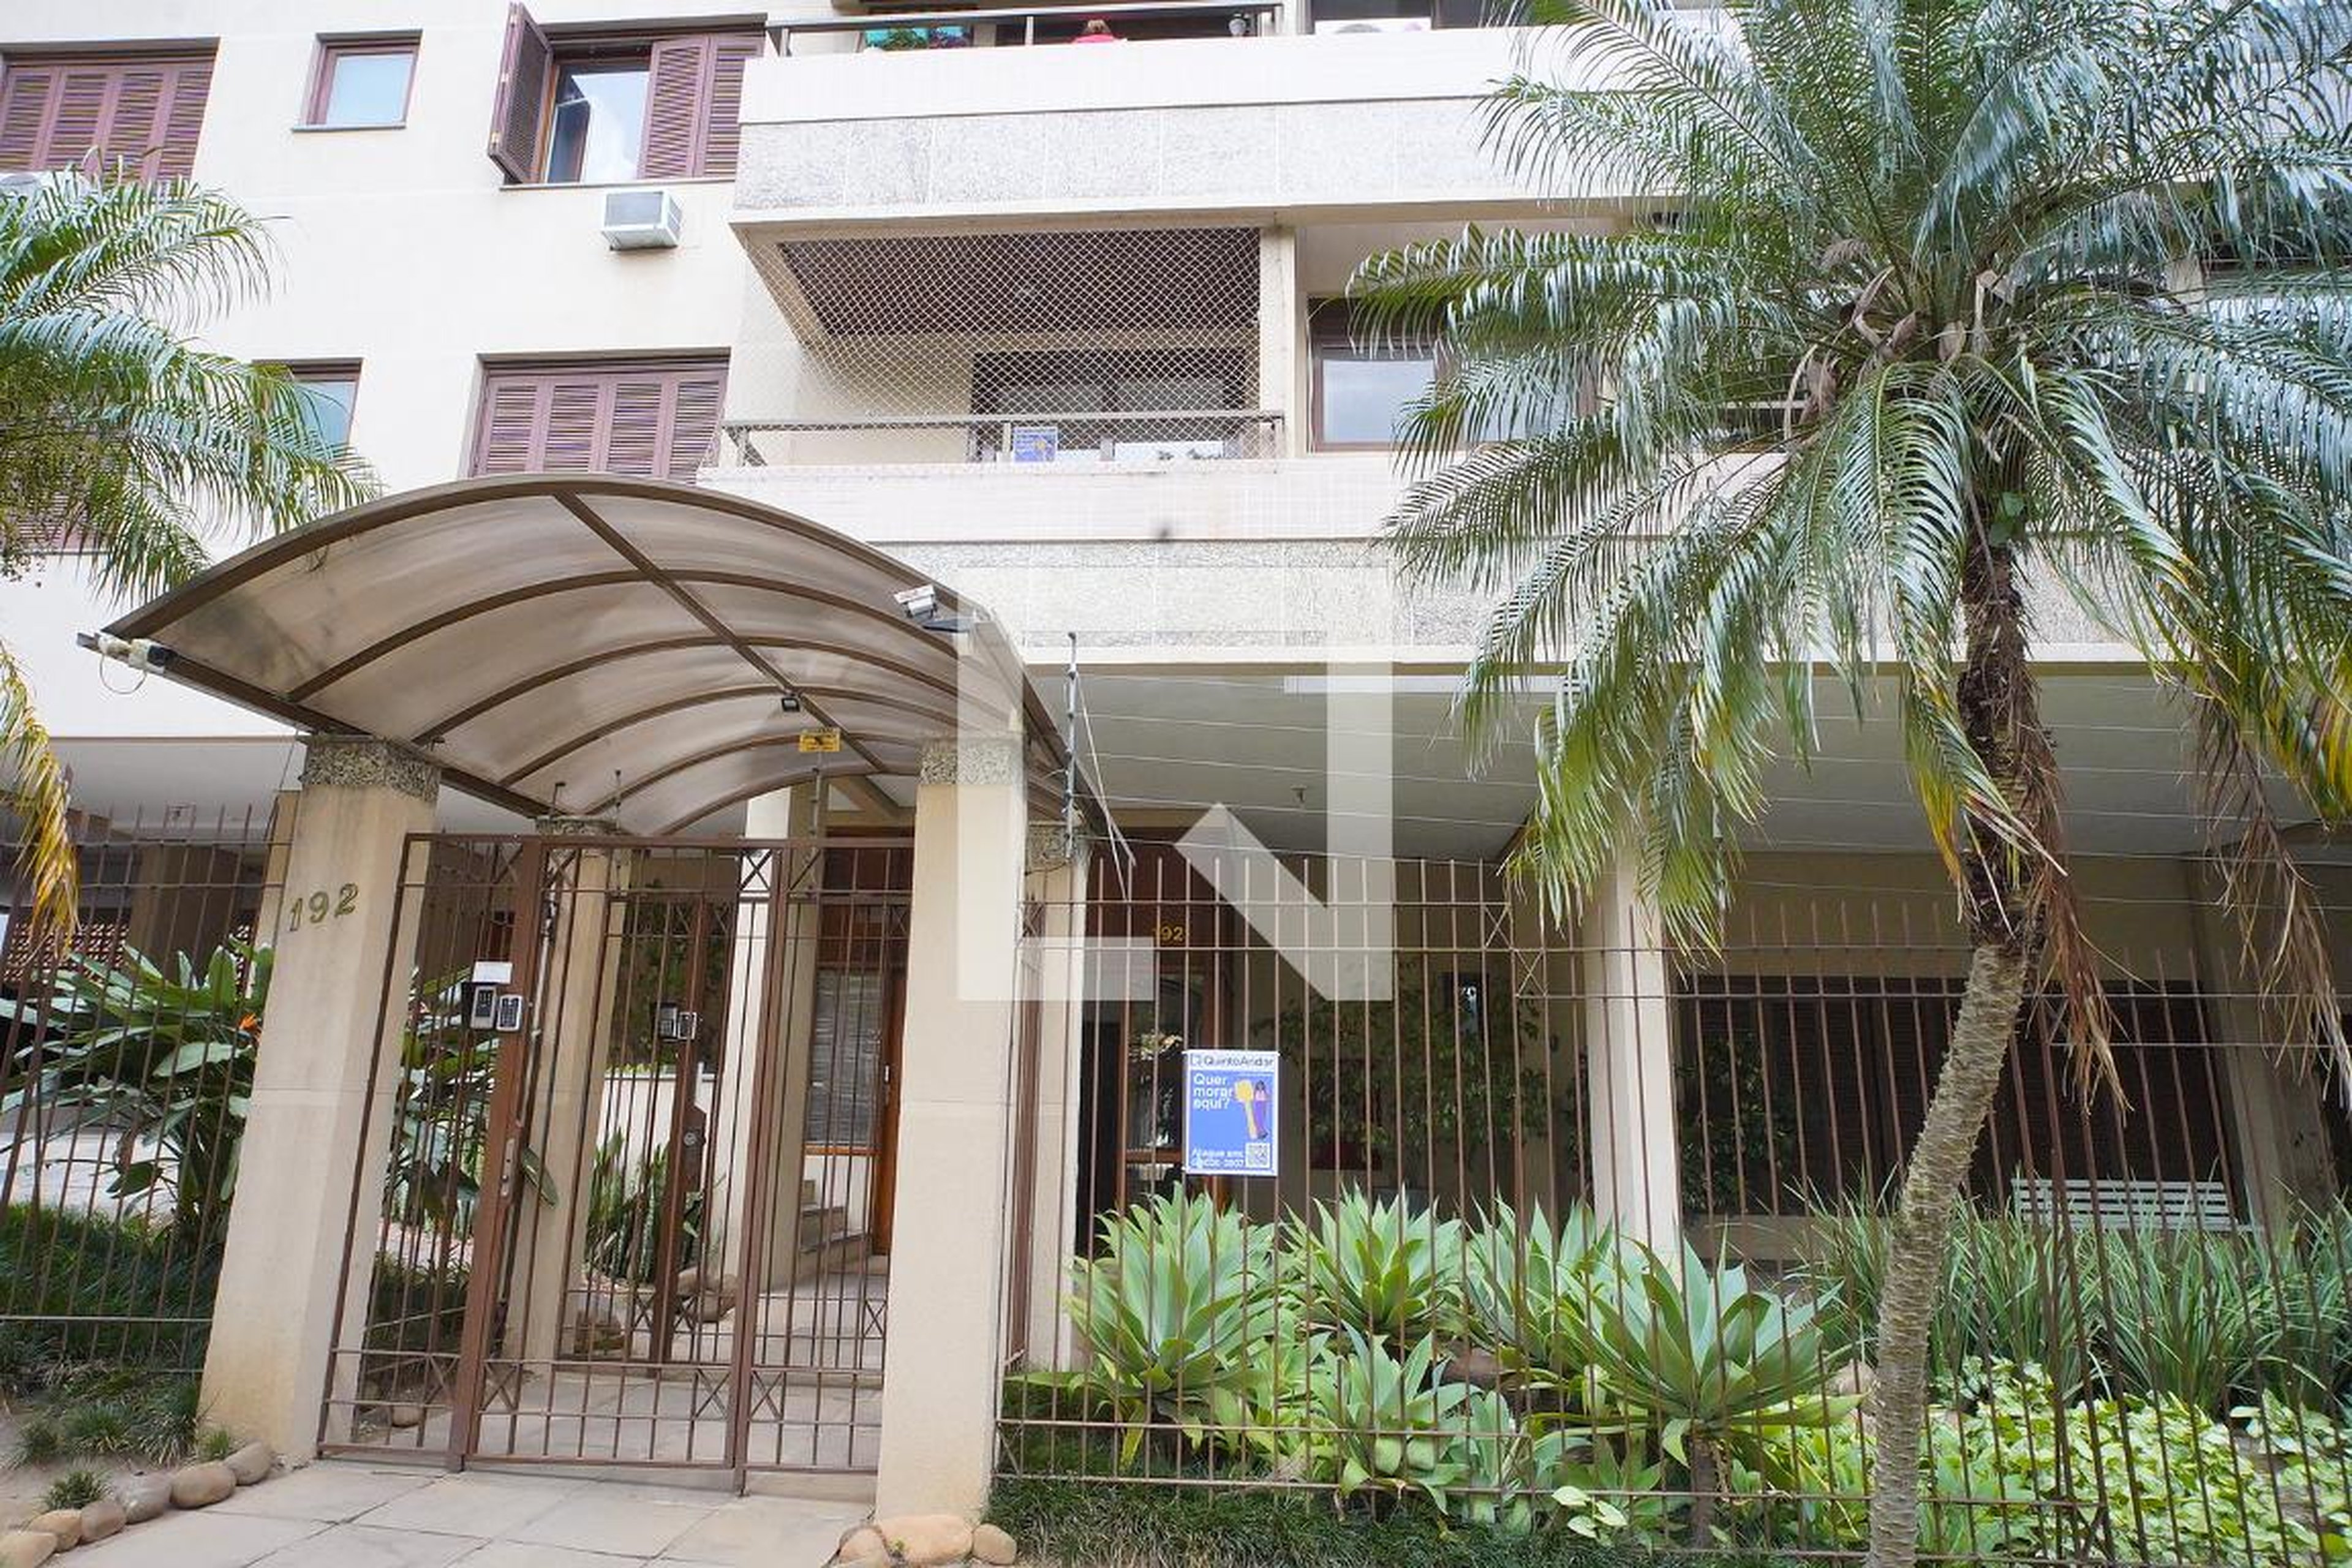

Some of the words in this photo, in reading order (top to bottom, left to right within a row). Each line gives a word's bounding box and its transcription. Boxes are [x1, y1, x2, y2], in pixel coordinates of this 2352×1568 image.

[289, 883, 359, 932] 192
[1193, 1072, 1227, 1085] Quer
[1193, 1087, 1233, 1097] morar
[1193, 1097, 1230, 1110] aqui?
